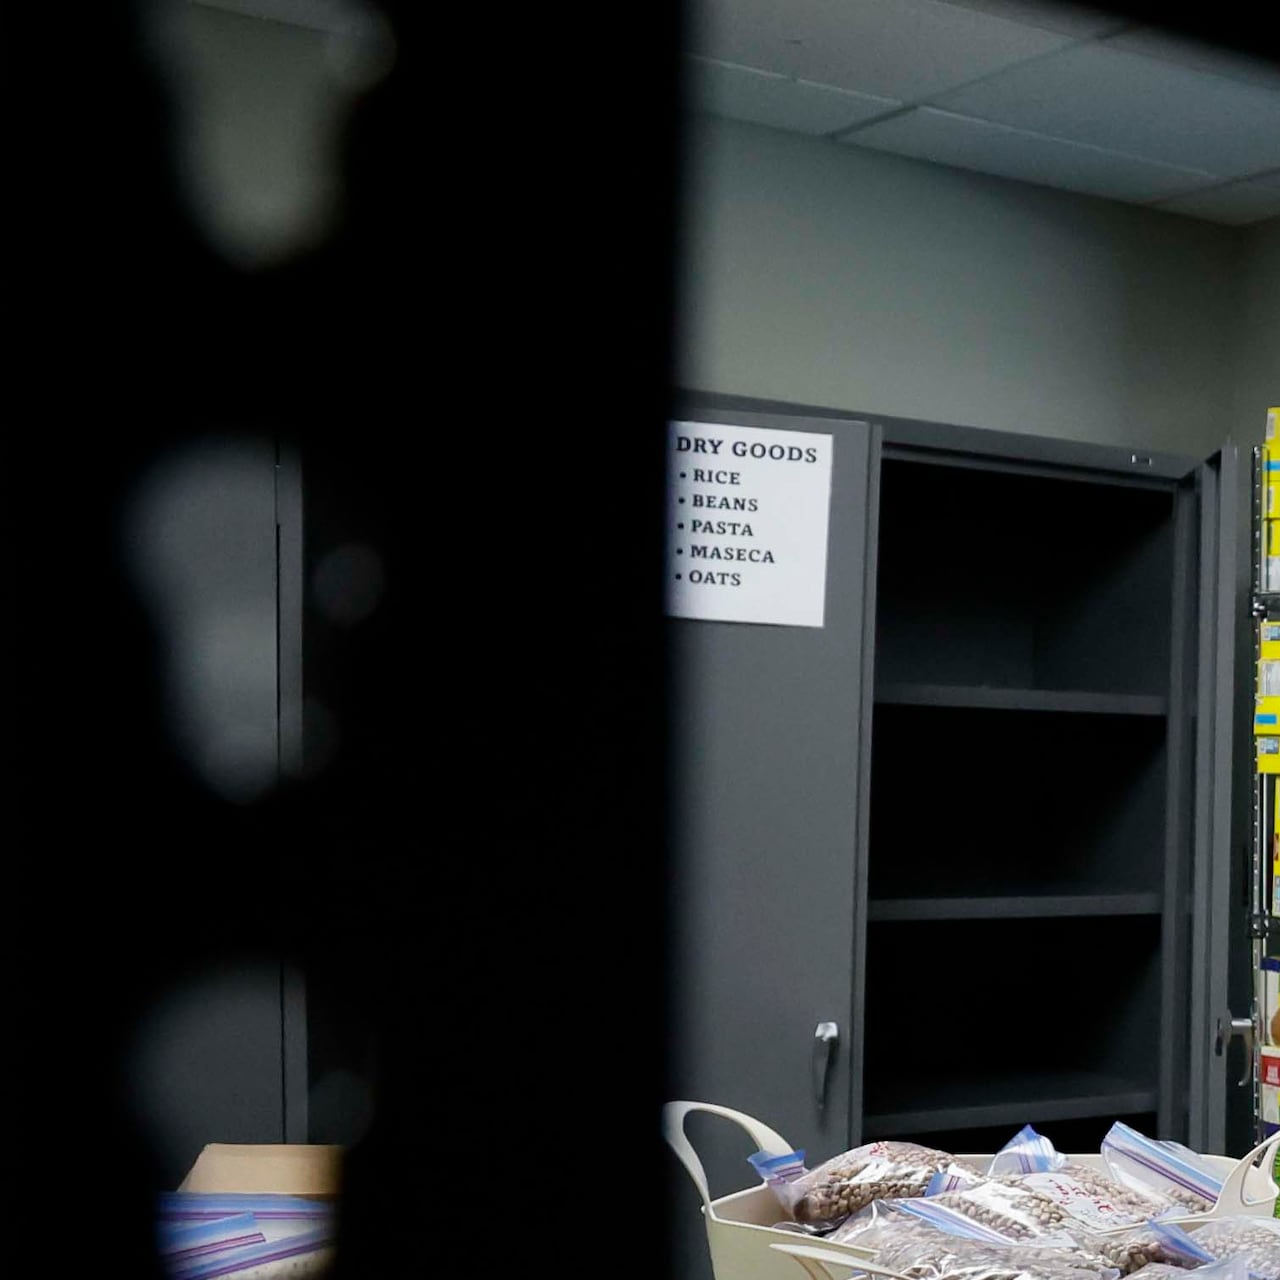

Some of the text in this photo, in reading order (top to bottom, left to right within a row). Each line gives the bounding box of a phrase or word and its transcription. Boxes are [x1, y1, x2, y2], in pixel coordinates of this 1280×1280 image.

[677, 436, 818, 463] DRY GOODS
[693, 469, 742, 485] RICE
[692, 494, 759, 512] BEANS
[691, 520, 755, 536] PASTA
[690, 545, 776, 563] MASECA
[689, 570, 742, 587] OATS
